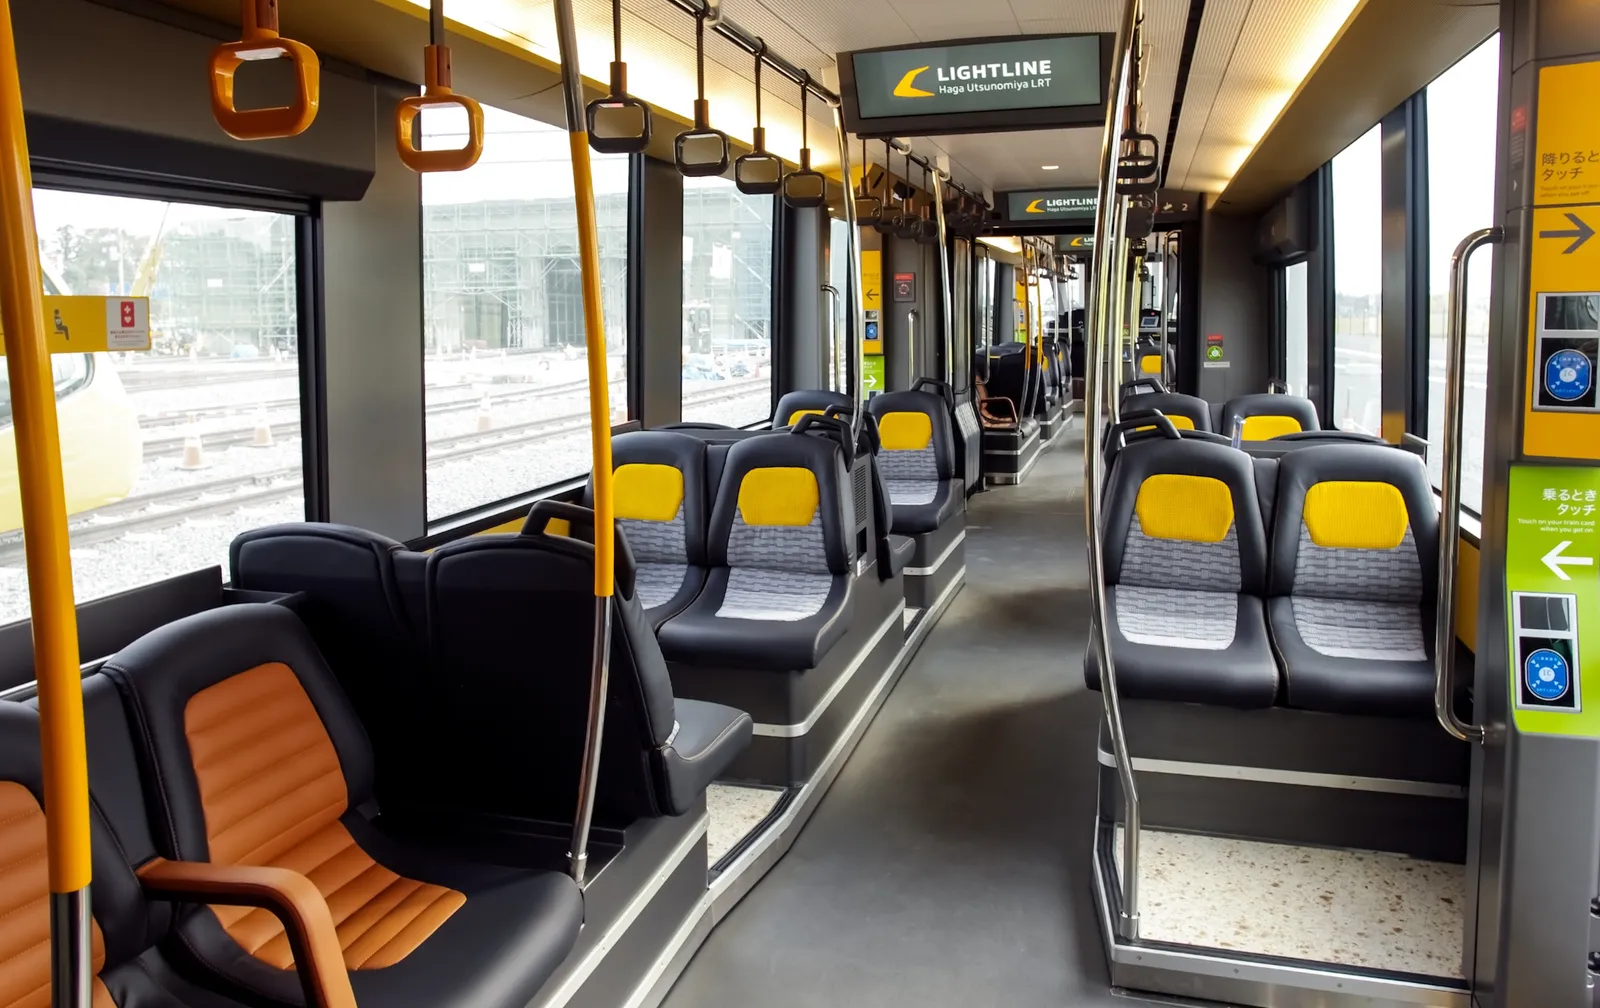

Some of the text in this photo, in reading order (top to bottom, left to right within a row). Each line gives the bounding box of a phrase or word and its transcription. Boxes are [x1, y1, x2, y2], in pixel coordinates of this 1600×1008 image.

[937, 60, 1052, 81] LIGHTLINE
[939, 78, 1052, 95] Haga Utsunomiya LRT
[1542, 166, 1584, 181] タッチ
[1182, 203, 1188, 211] 2
[1542, 488, 1597, 502] 乗るとき
[1557, 503, 1596, 516] タッチ
